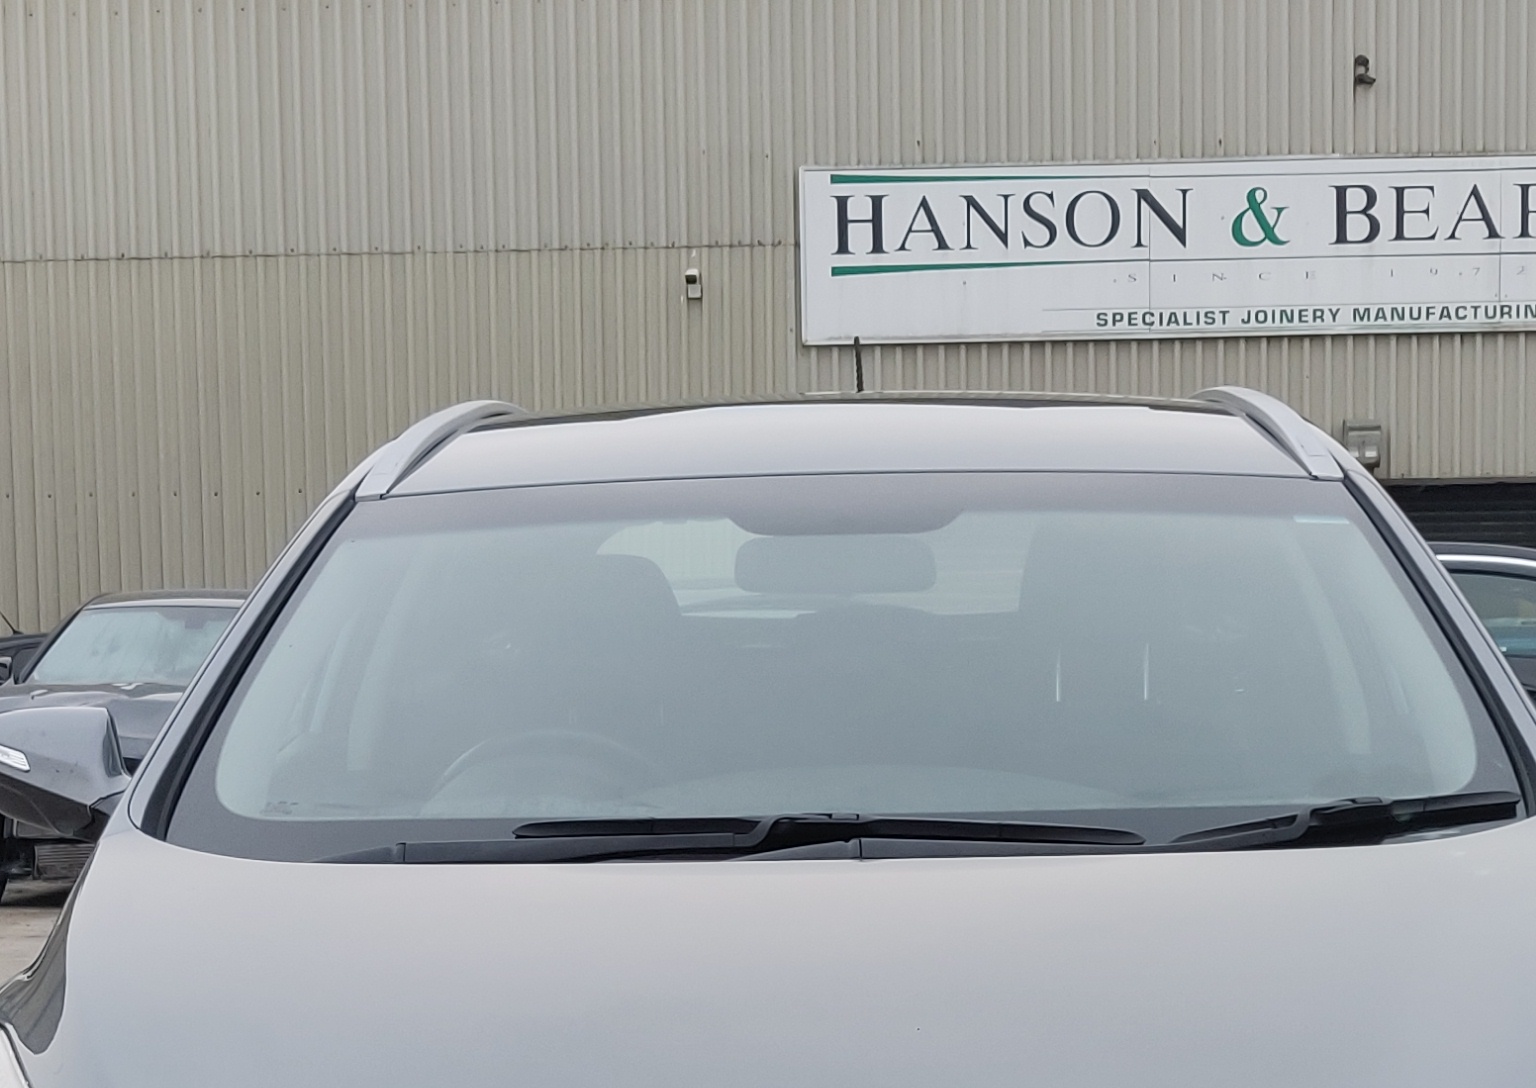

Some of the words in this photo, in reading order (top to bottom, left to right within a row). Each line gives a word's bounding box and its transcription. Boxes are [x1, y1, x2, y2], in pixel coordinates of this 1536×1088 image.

[830, 188, 1194, 255] HANSON
[1231, 186, 1291, 247] &
[1095, 310, 1231, 327] SPECIALIST
[1240, 308, 1341, 325] JOINERY
